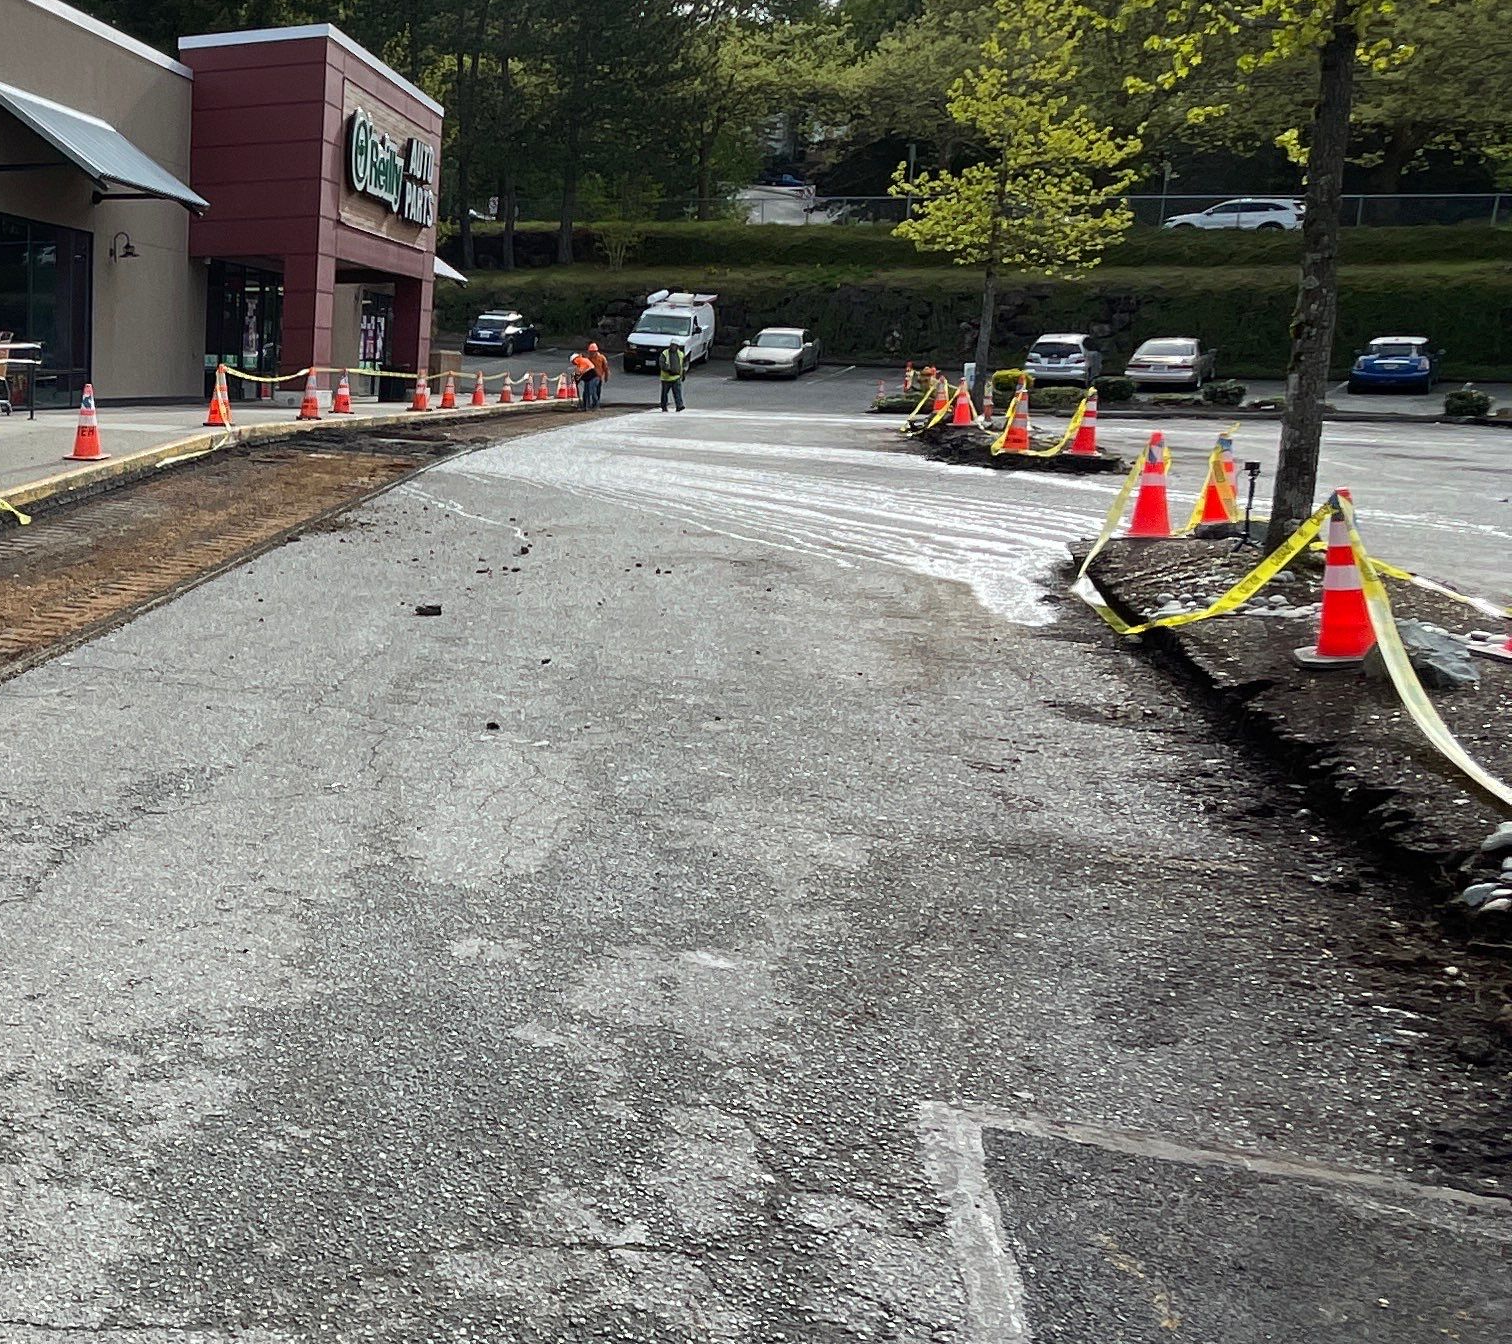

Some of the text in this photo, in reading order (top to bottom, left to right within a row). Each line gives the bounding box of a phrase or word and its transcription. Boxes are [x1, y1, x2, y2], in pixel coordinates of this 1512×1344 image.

[352, 107, 404, 212] O'Reilly
[408, 139, 434, 184] AUTO
[404, 181, 433, 227] PARTS
